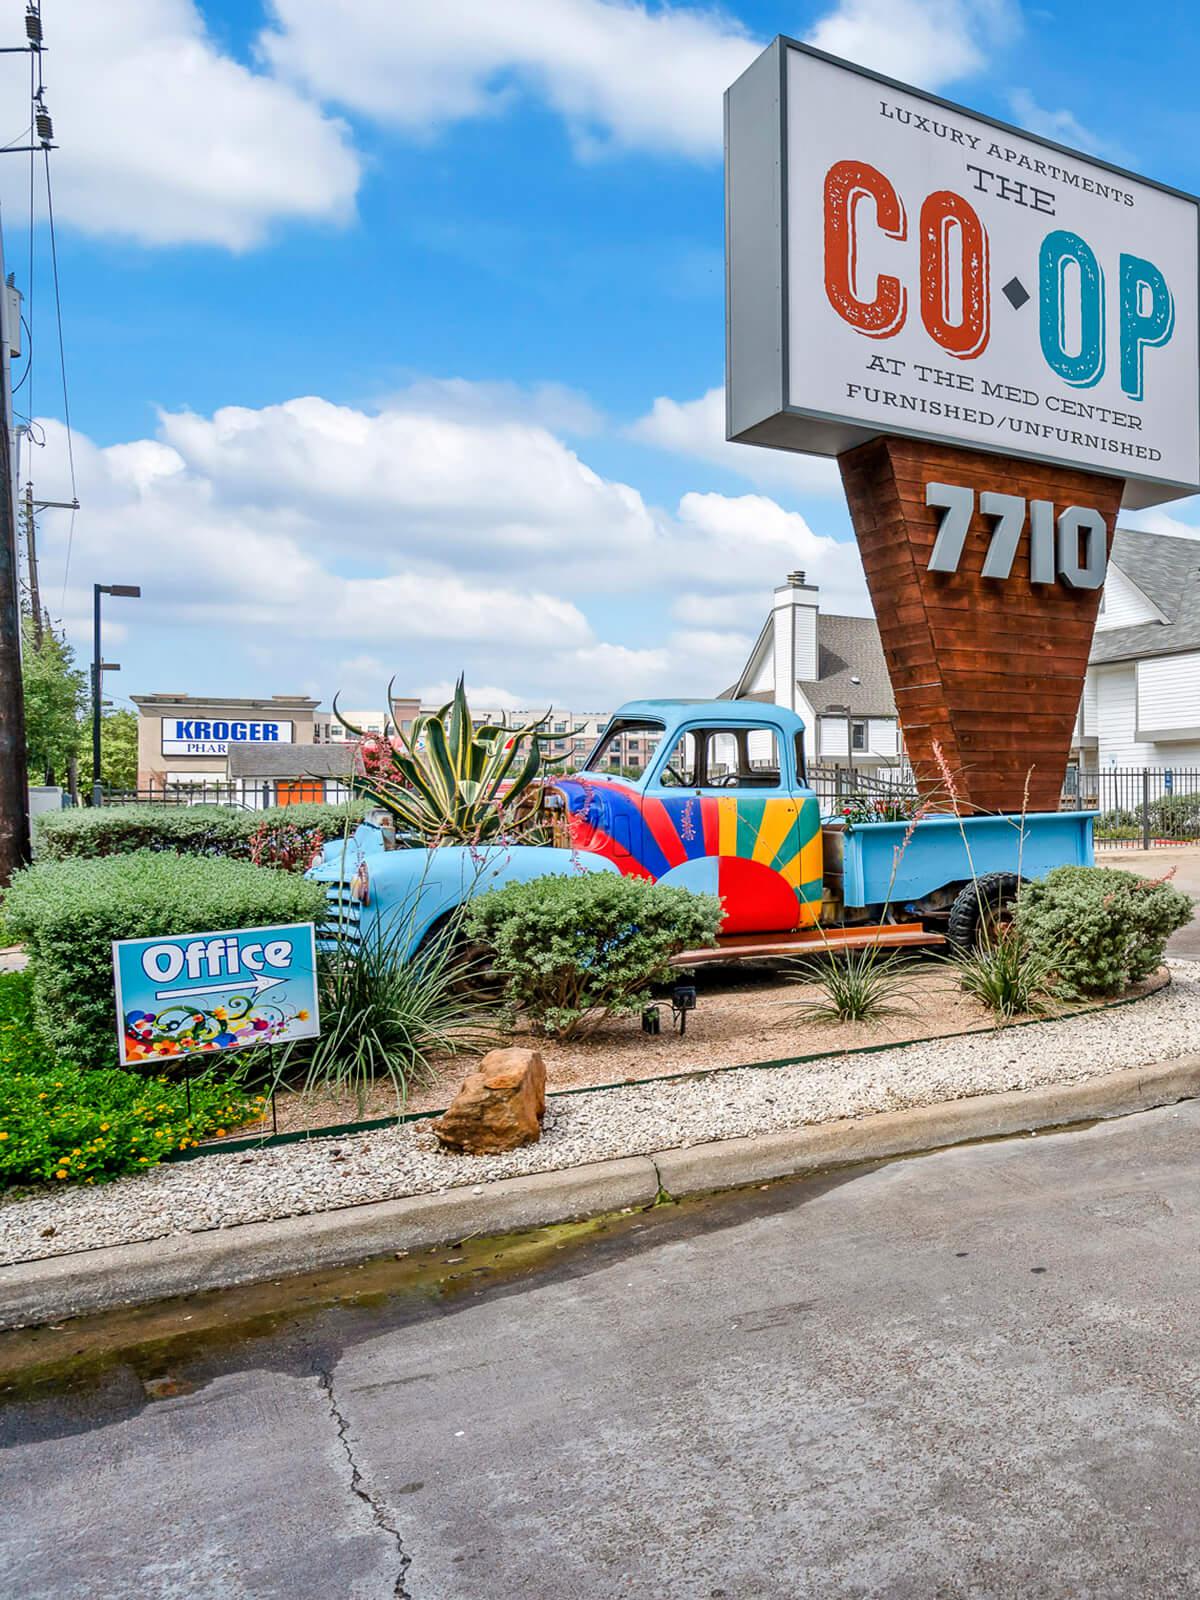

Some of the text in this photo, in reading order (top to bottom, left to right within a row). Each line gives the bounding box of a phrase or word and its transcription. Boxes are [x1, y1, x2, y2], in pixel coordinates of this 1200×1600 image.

[879, 101, 1135, 207] LUXURY APARTMENTS
[966, 163, 1056, 217] THE
[846, 383, 1163, 462] FURNISHED/UNFURNISHED
[866, 354, 1143, 431] AT THE MED CENTER
[926, 482, 1107, 590] 7710
[176, 721, 279, 741] KROGER
[187, 743, 227, 753] PHAR
[141, 936, 294, 983] Office
